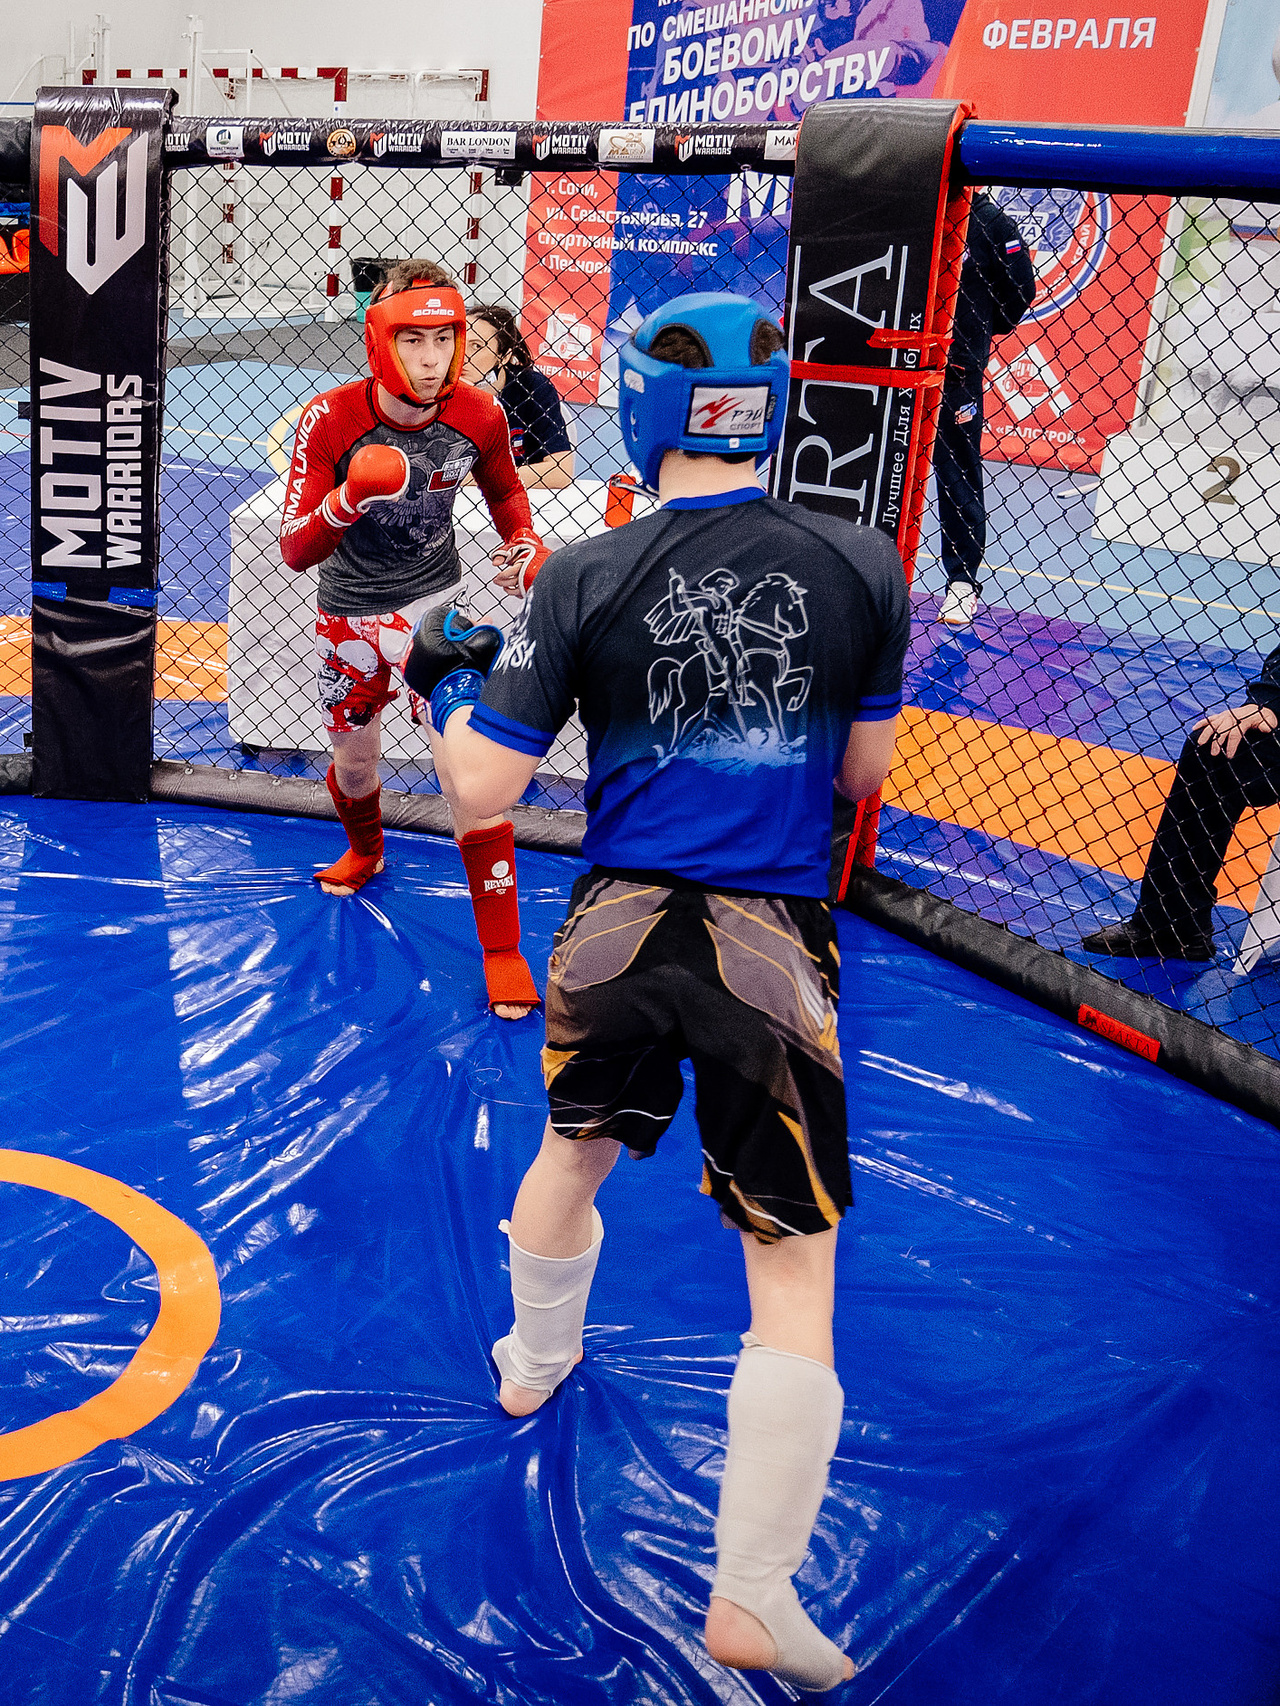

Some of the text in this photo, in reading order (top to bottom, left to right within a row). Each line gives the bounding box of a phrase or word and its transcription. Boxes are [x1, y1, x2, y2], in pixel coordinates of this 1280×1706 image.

[627, 0, 815, 51] ПО СМЕШАННО
[982, 17, 1157, 50] ФЕВРАЛЯ
[662, 14, 817, 86] БОЕВОМУ
[165, 133, 191, 146] OTIV
[277, 132, 312, 144] MOTIV
[388, 133, 424, 145] MOTIV
[446, 138, 511, 146] BAR LONDON
[551, 134, 590, 147] MOTIV
[694, 134, 736, 148] MOTIV
[277, 144, 310, 152] WARRIORS
[551, 147, 587, 155] WARRIORS
[694, 147, 732, 155] WARRIORS
[686, 210, 709, 229] 27
[638, 238, 719, 257] комплекс
[566, 368, 597, 382] ТРАНС
[294, 399, 331, 475] UNION
[39, 357, 102, 569] MOTIV
[106, 374, 142, 569] WARRIORS
[882, 451, 905, 528] Лучшее
[894, 405, 911, 446] Для
[1201, 456, 1241, 506] 2
[1101, 1021, 1151, 1058] SPARTA
